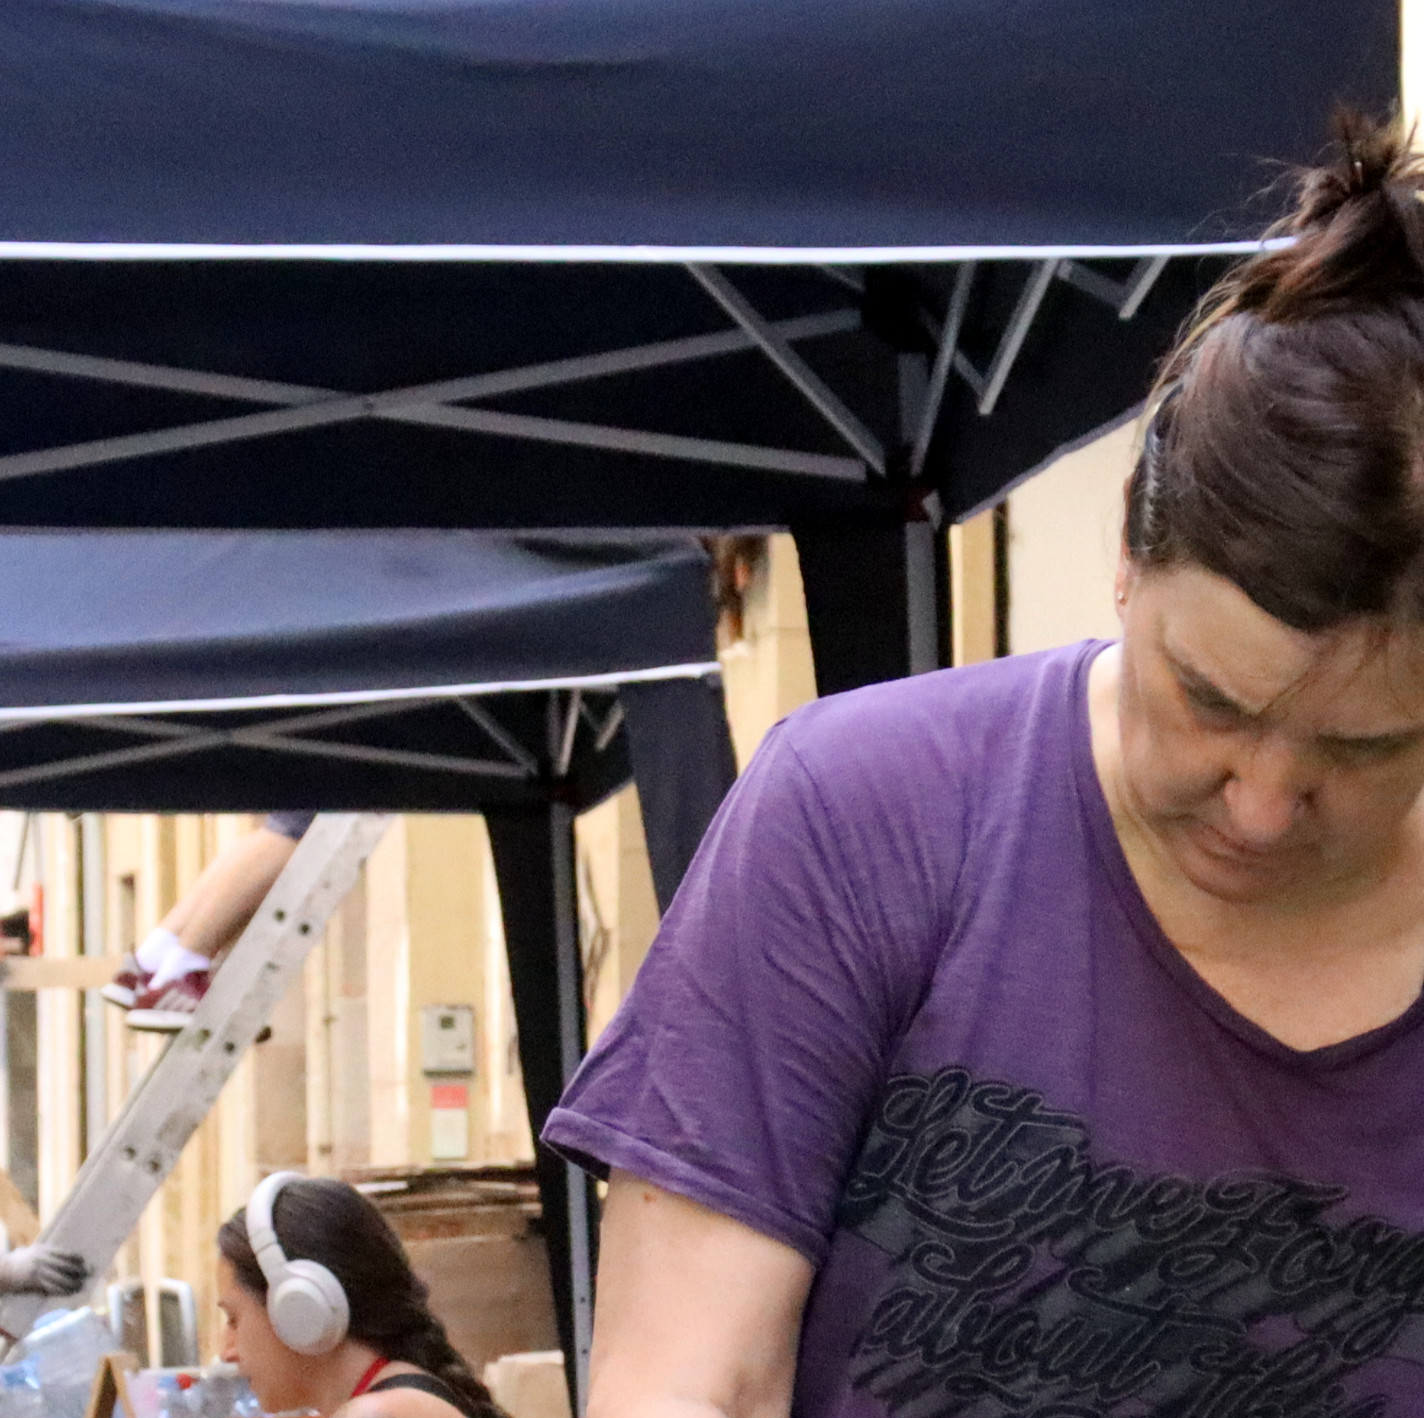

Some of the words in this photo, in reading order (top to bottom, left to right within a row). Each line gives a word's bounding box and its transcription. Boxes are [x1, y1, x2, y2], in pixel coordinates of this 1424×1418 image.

[842, 1064, 1087, 1237] Let
[1022, 1142, 1207, 1231] me
[869, 1242, 1247, 1400] about
